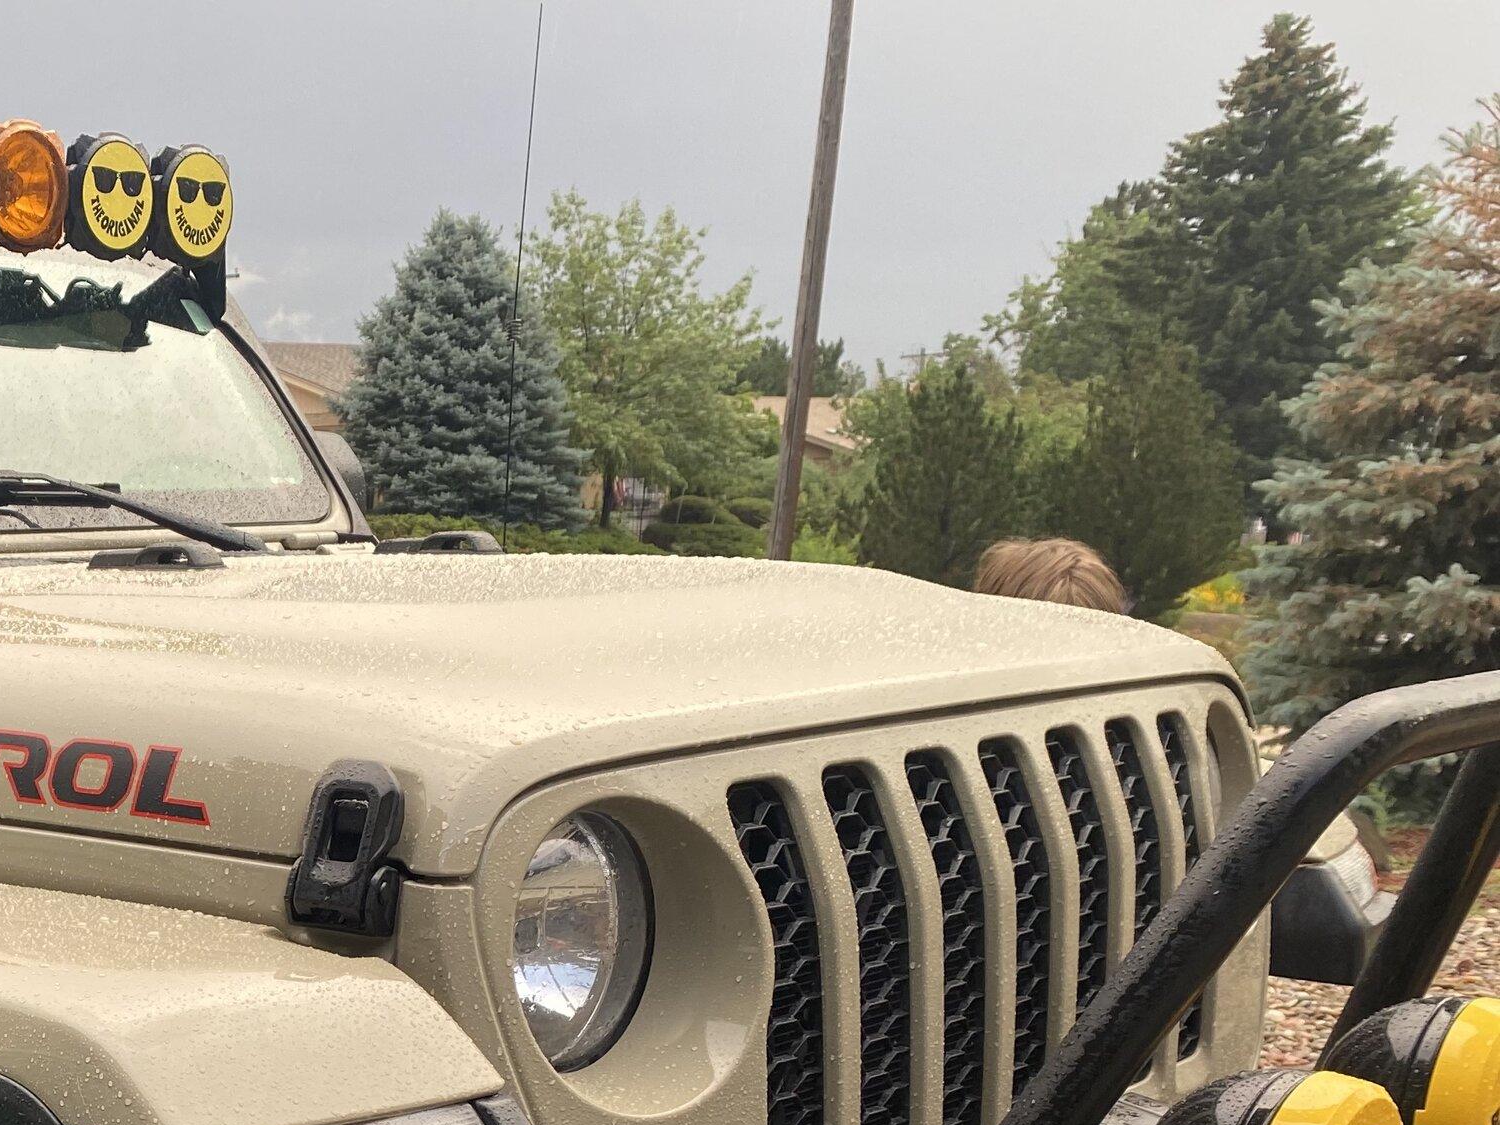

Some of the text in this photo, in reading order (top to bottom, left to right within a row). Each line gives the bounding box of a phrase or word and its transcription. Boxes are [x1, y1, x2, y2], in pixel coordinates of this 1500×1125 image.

[91, 195, 145, 238] THE ORIGINAL
[183, 209, 225, 246] ORIGINAL
